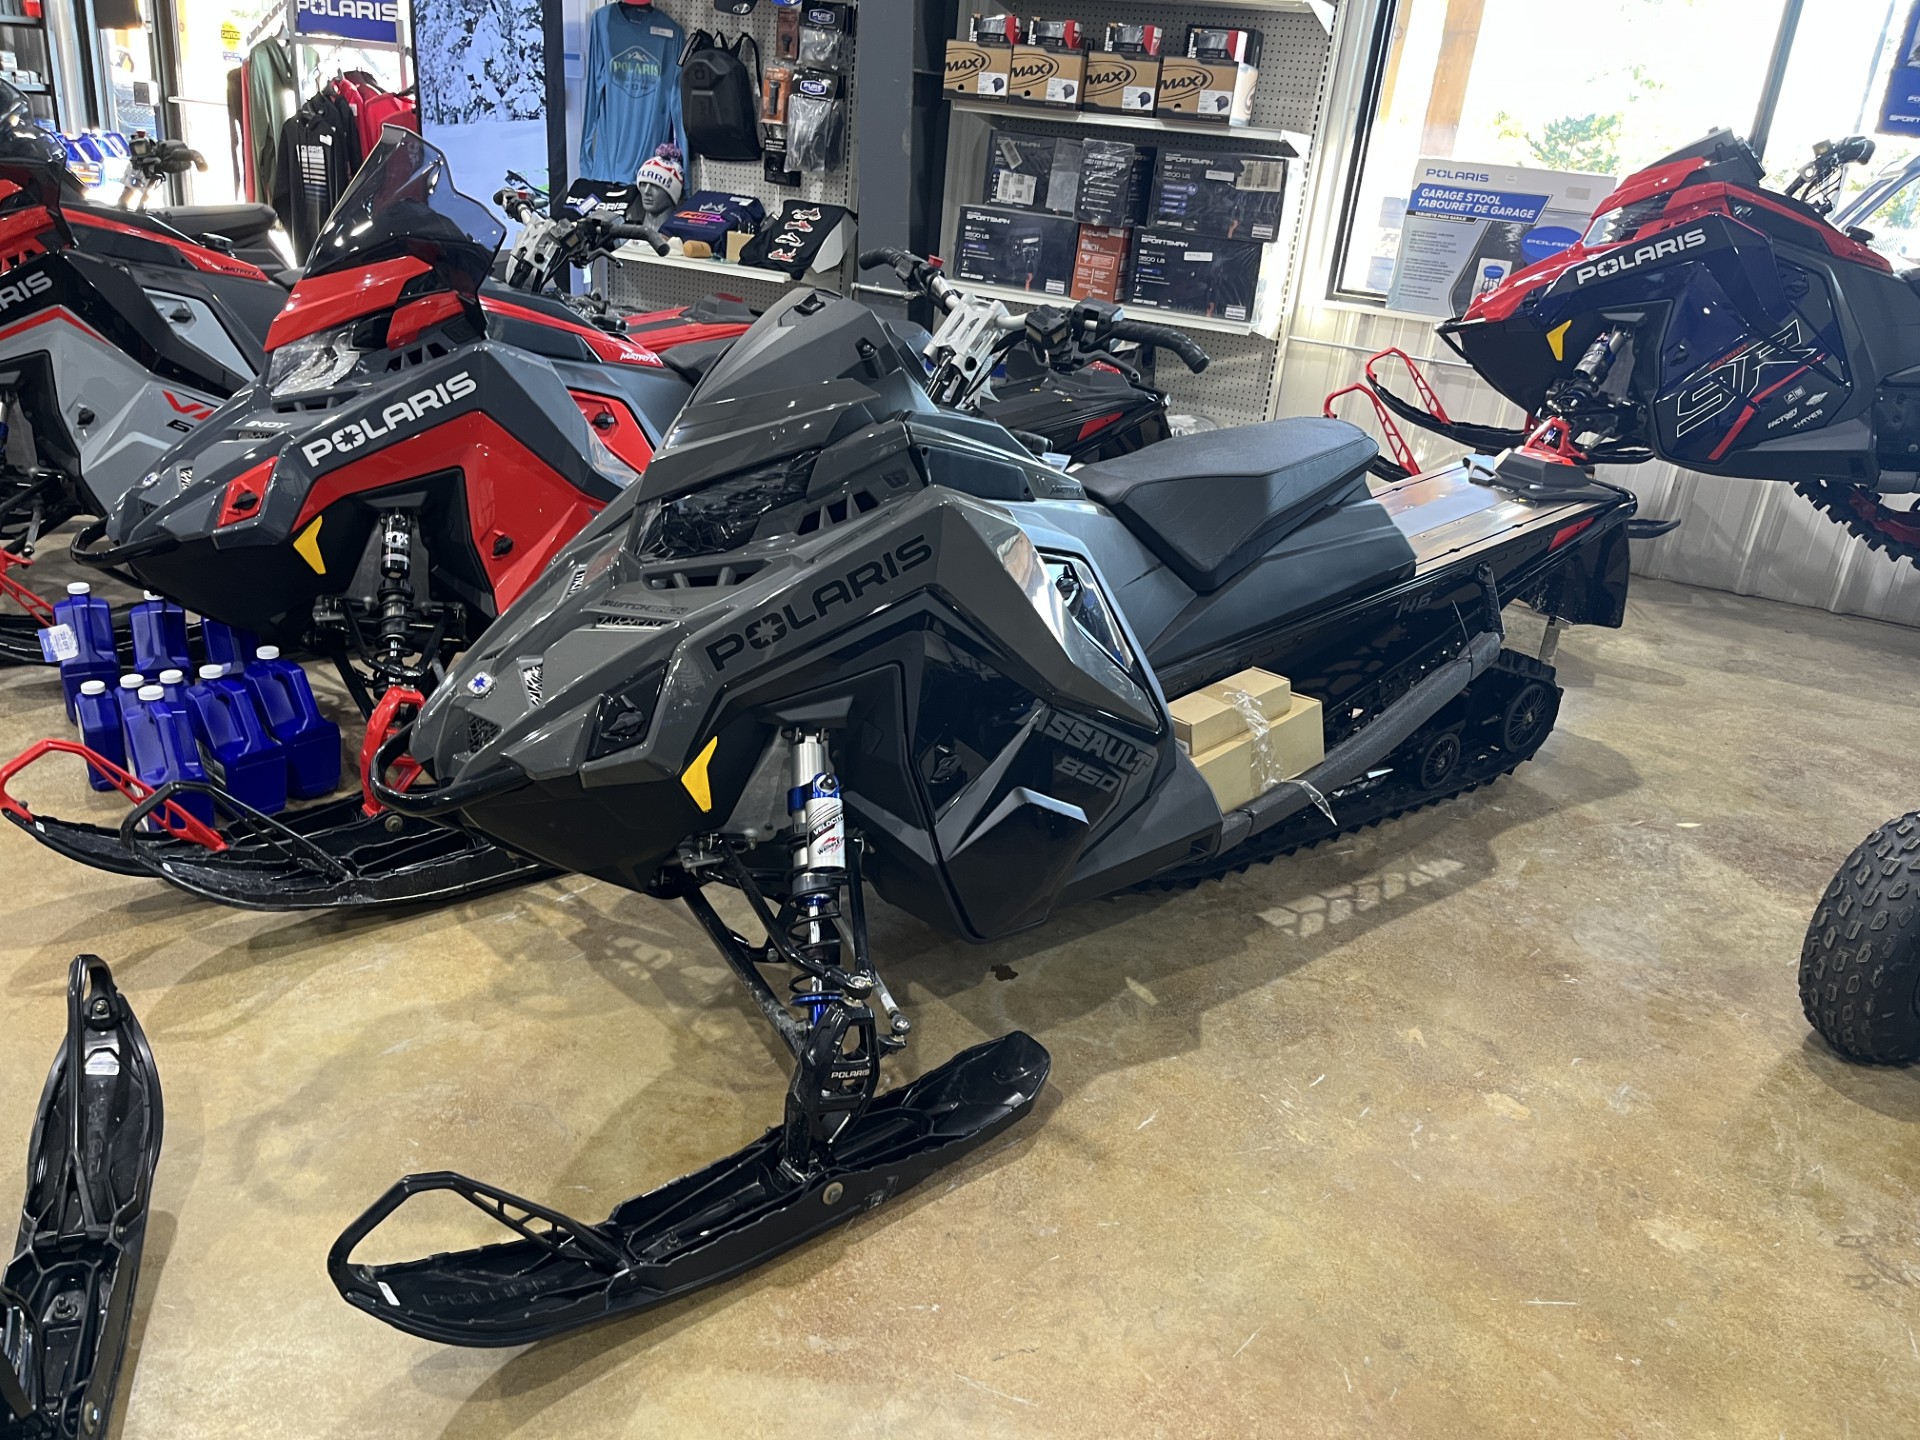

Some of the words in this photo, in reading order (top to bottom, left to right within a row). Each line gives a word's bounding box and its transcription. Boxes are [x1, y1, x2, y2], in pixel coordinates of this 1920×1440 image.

[297, 0, 399, 22] POLARIS
[613, 61, 660, 76] POLARIS
[803, 82, 823, 91] PURE
[1165, 156, 1214, 166] SPORTSMAN
[1426, 168, 1490, 183] POLARIS
[1421, 188, 1464, 202] GARAGE
[1466, 194, 1501, 206] STOOL
[1418, 198, 1472, 212] TABOURET
[1473, 203, 1489, 214] DE
[1490, 206, 1536, 219] GARAGE
[966, 214, 1010, 224] SPORTSMAN
[1141, 238, 1188, 247] SPORTSMAN
[1576, 228, 1707, 285] POLARIS
[0, 270, 53, 312] RIS
[1709, 343, 1750, 371] PATRIOT
[244, 420, 291, 429] INDY
[301, 371, 477, 468] POLARIS
[705, 534, 932, 673] POLARIS
[1015, 698, 1154, 776] ASSAULT
[1055, 755, 1121, 794] 850
[830, 1068, 870, 1079] POLARIS
